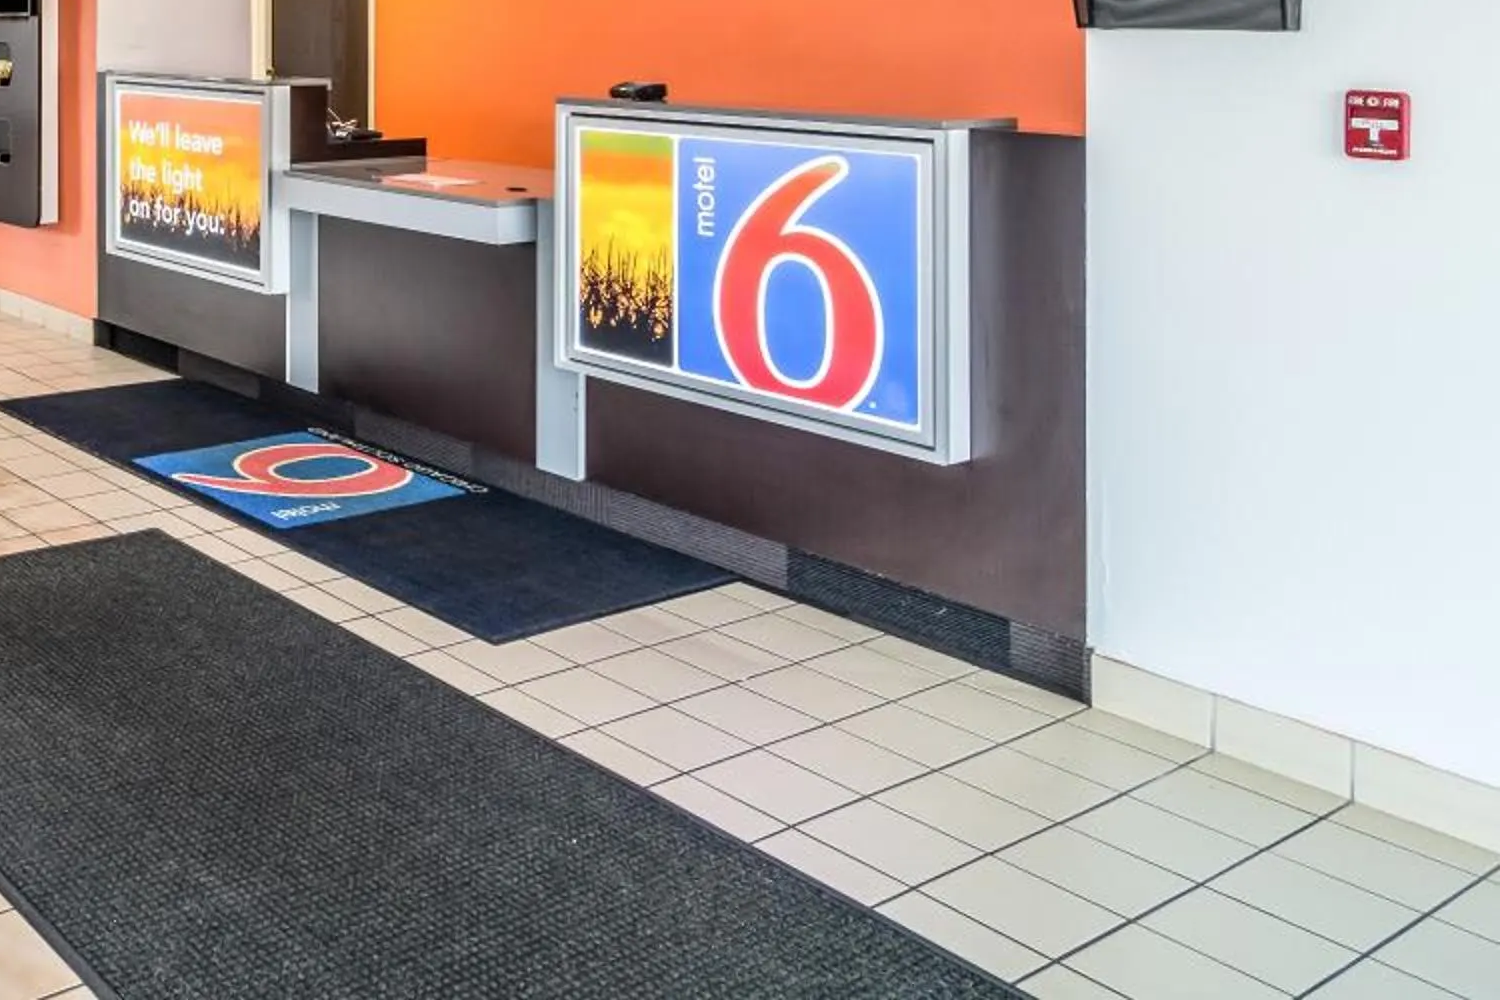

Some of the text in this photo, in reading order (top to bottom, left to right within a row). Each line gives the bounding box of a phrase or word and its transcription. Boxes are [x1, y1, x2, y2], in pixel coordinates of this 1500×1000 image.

[129, 120, 223, 156] We'll leave
[130, 157, 203, 194] the light
[129, 200, 149, 219] on
[154, 196, 181, 225] for
[692, 155, 884, 413] motel 6
[171, 443, 415, 498] 6
